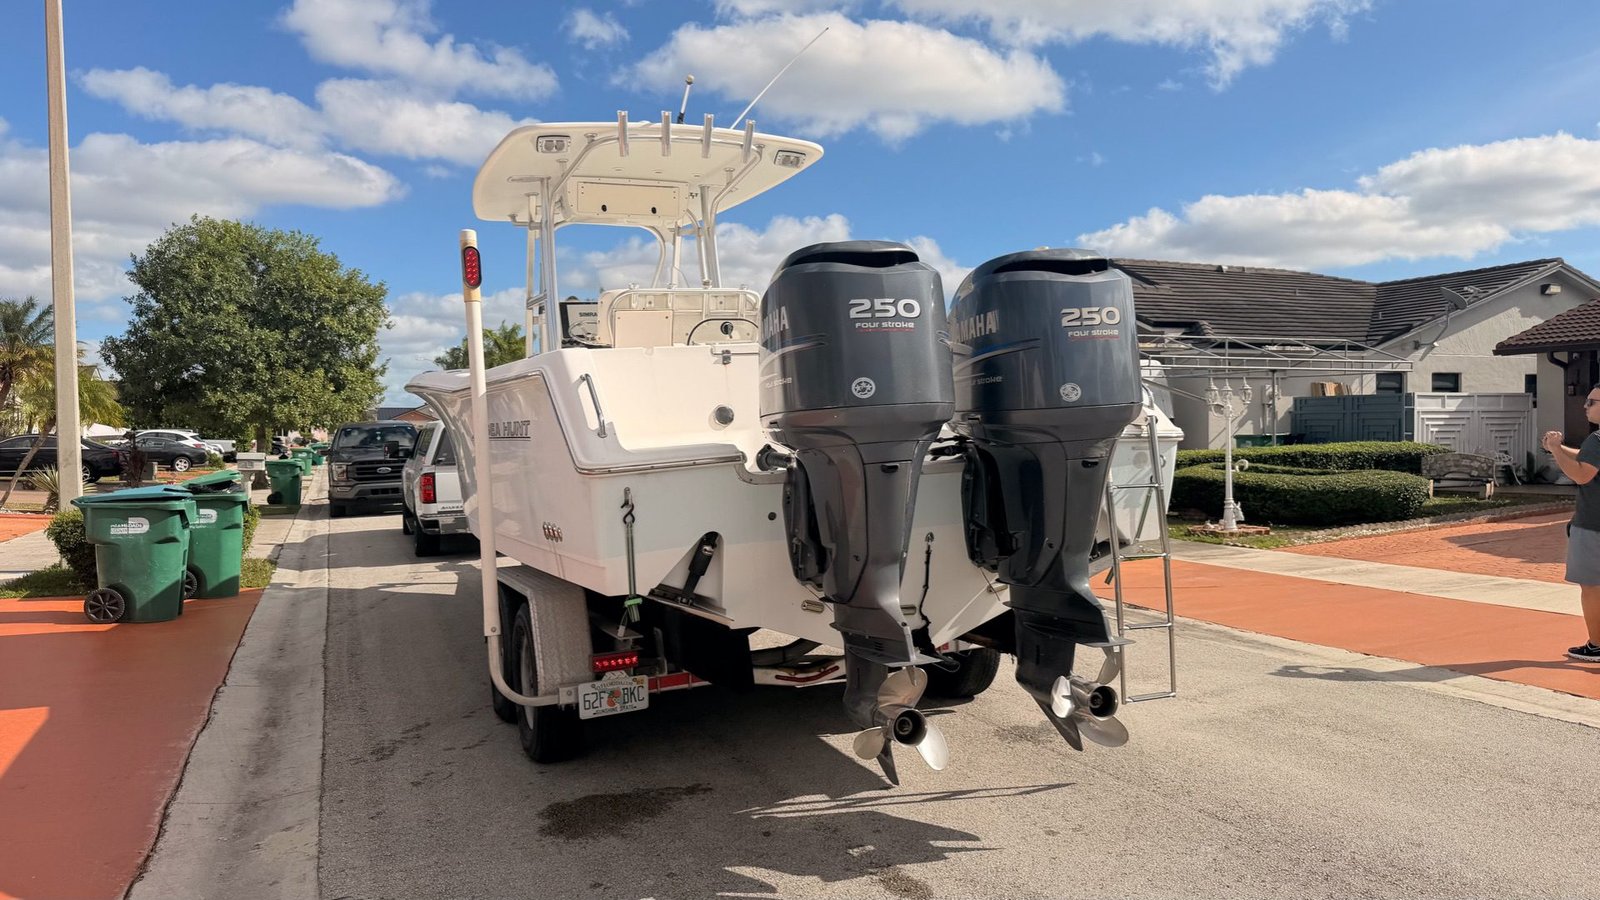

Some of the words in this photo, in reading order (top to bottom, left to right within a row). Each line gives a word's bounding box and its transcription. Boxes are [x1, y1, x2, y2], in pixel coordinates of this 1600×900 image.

[849, 298, 921, 319] 250
[1061, 306, 1120, 327] 250
[502, 420, 531, 437] HUNT
[583, 690, 607, 711] 62F
[622, 685, 645, 705] BKC
